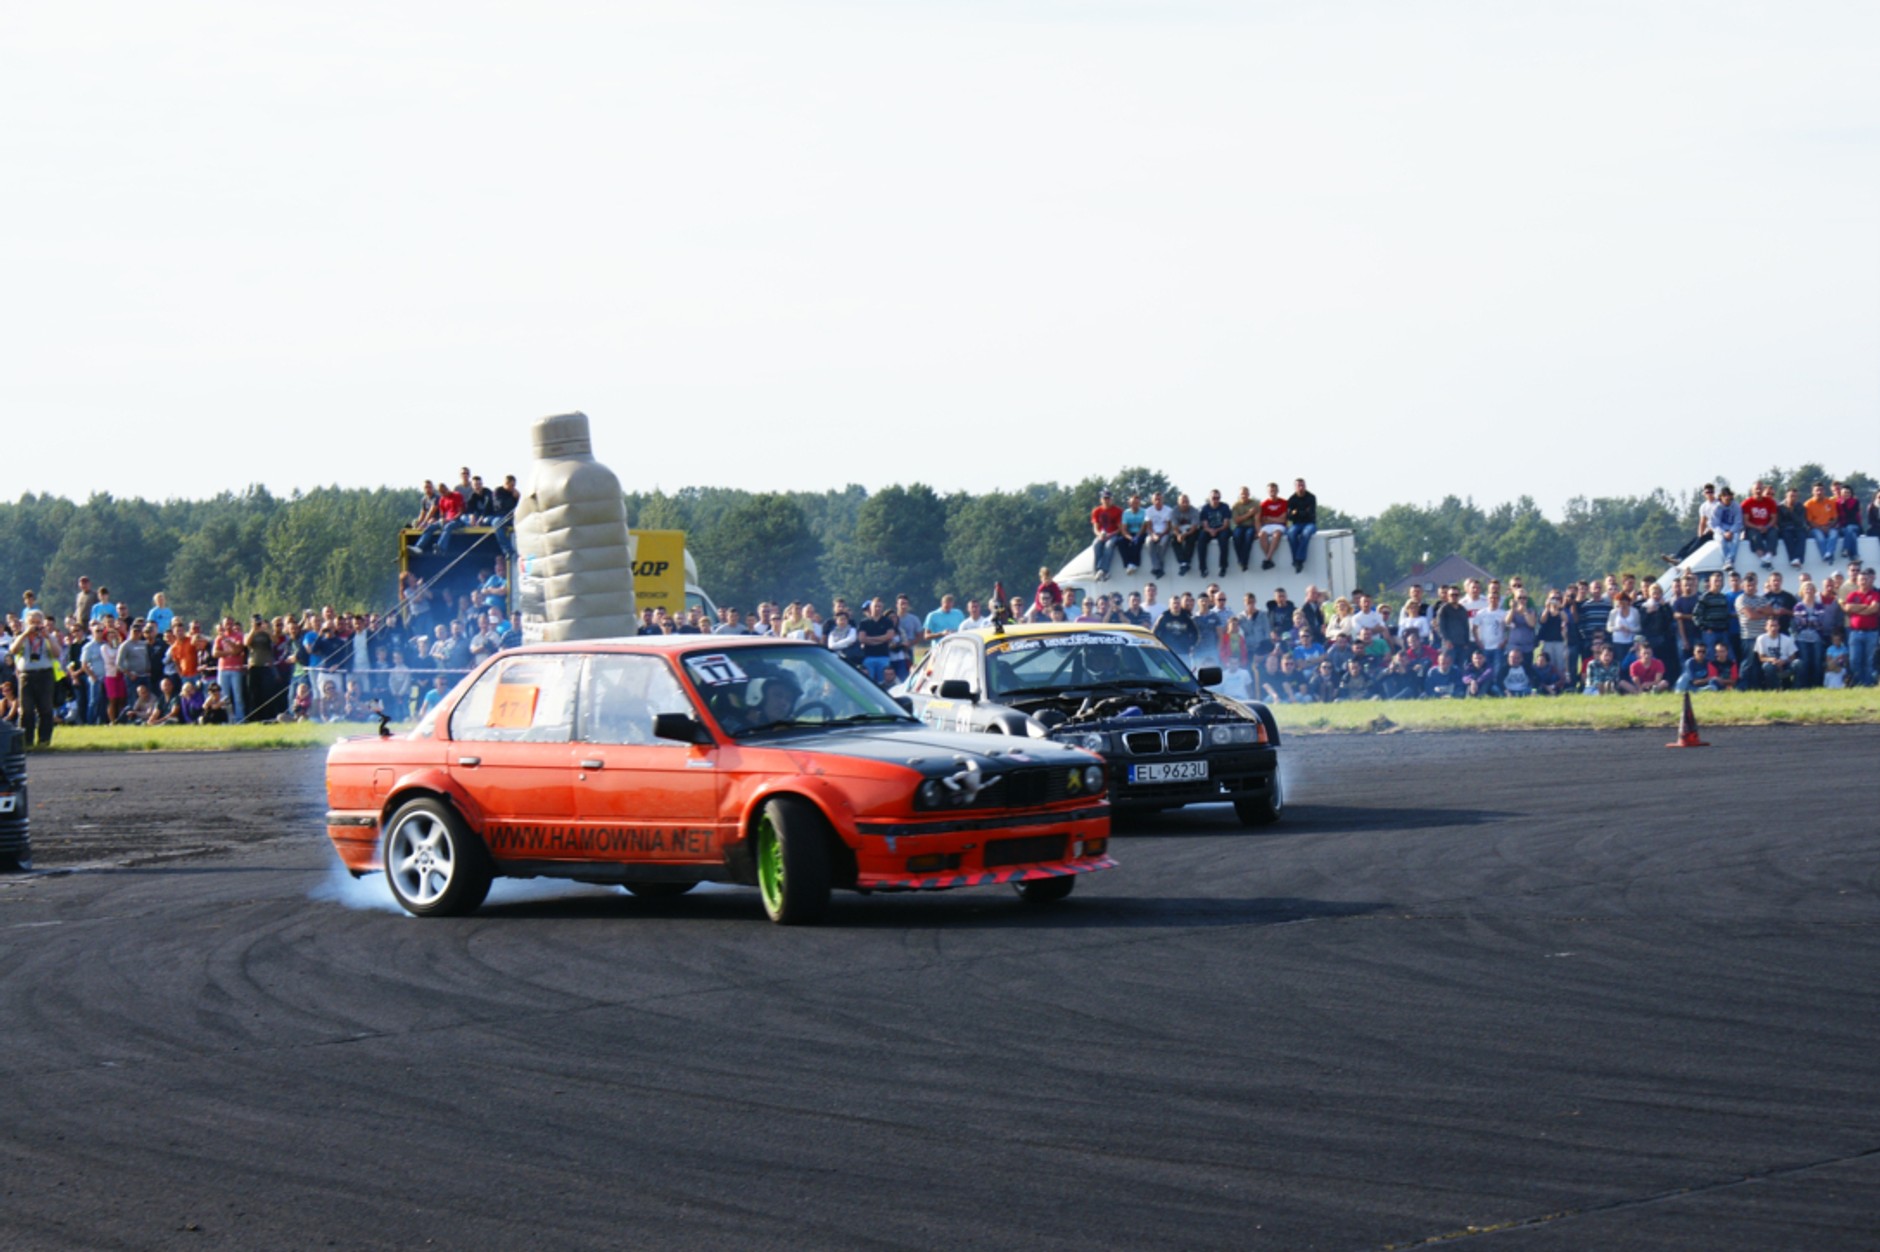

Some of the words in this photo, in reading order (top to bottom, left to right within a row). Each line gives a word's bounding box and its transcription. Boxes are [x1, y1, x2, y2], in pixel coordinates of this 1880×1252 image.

[701, 662, 734, 680] 17
[1137, 766, 1157, 780] EL
[1163, 763, 1206, 778] 9623U
[489, 825, 715, 853] WWW.HAMOWNIA.NET
